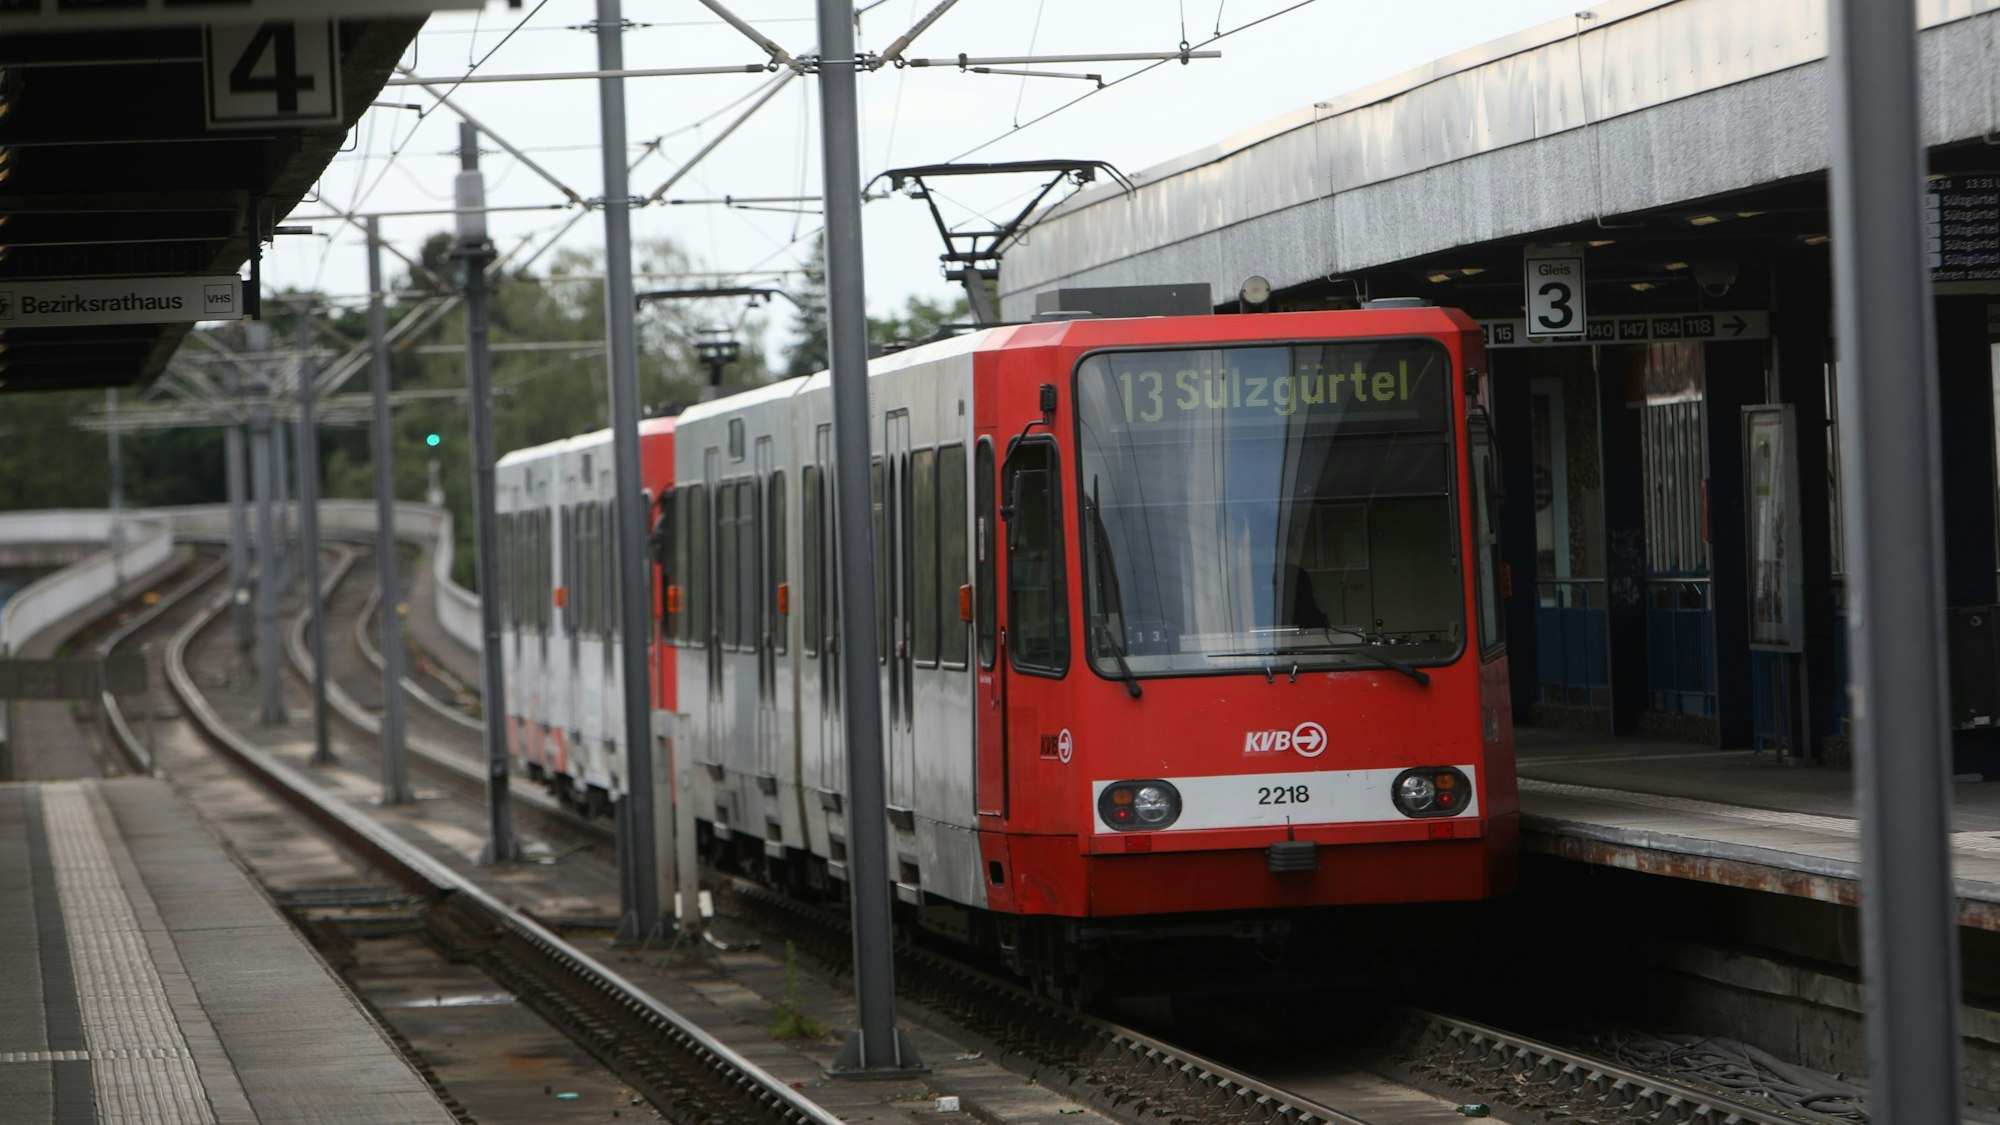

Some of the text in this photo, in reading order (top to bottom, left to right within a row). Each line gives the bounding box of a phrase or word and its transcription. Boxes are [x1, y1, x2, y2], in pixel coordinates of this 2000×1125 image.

[229, 19, 315, 114] 4
[1538, 263, 1571, 276] Gleis
[21, 293, 183, 314] Bezirksrathaus
[207, 293, 231, 304] VHS
[1537, 281, 1573, 329] 3
[1496, 327, 1512, 341] 15
[1587, 322, 1614, 337] 140
[1622, 322, 1646, 336] 147
[1653, 320, 1680, 335] 184
[1685, 319, 1712, 334] 118
[1120, 359, 1408, 423] 13 Sülzgürtel
[1040, 735, 1058, 756] KVB
[1244, 730, 1292, 753] KVB
[1258, 785, 1310, 805] 2218
